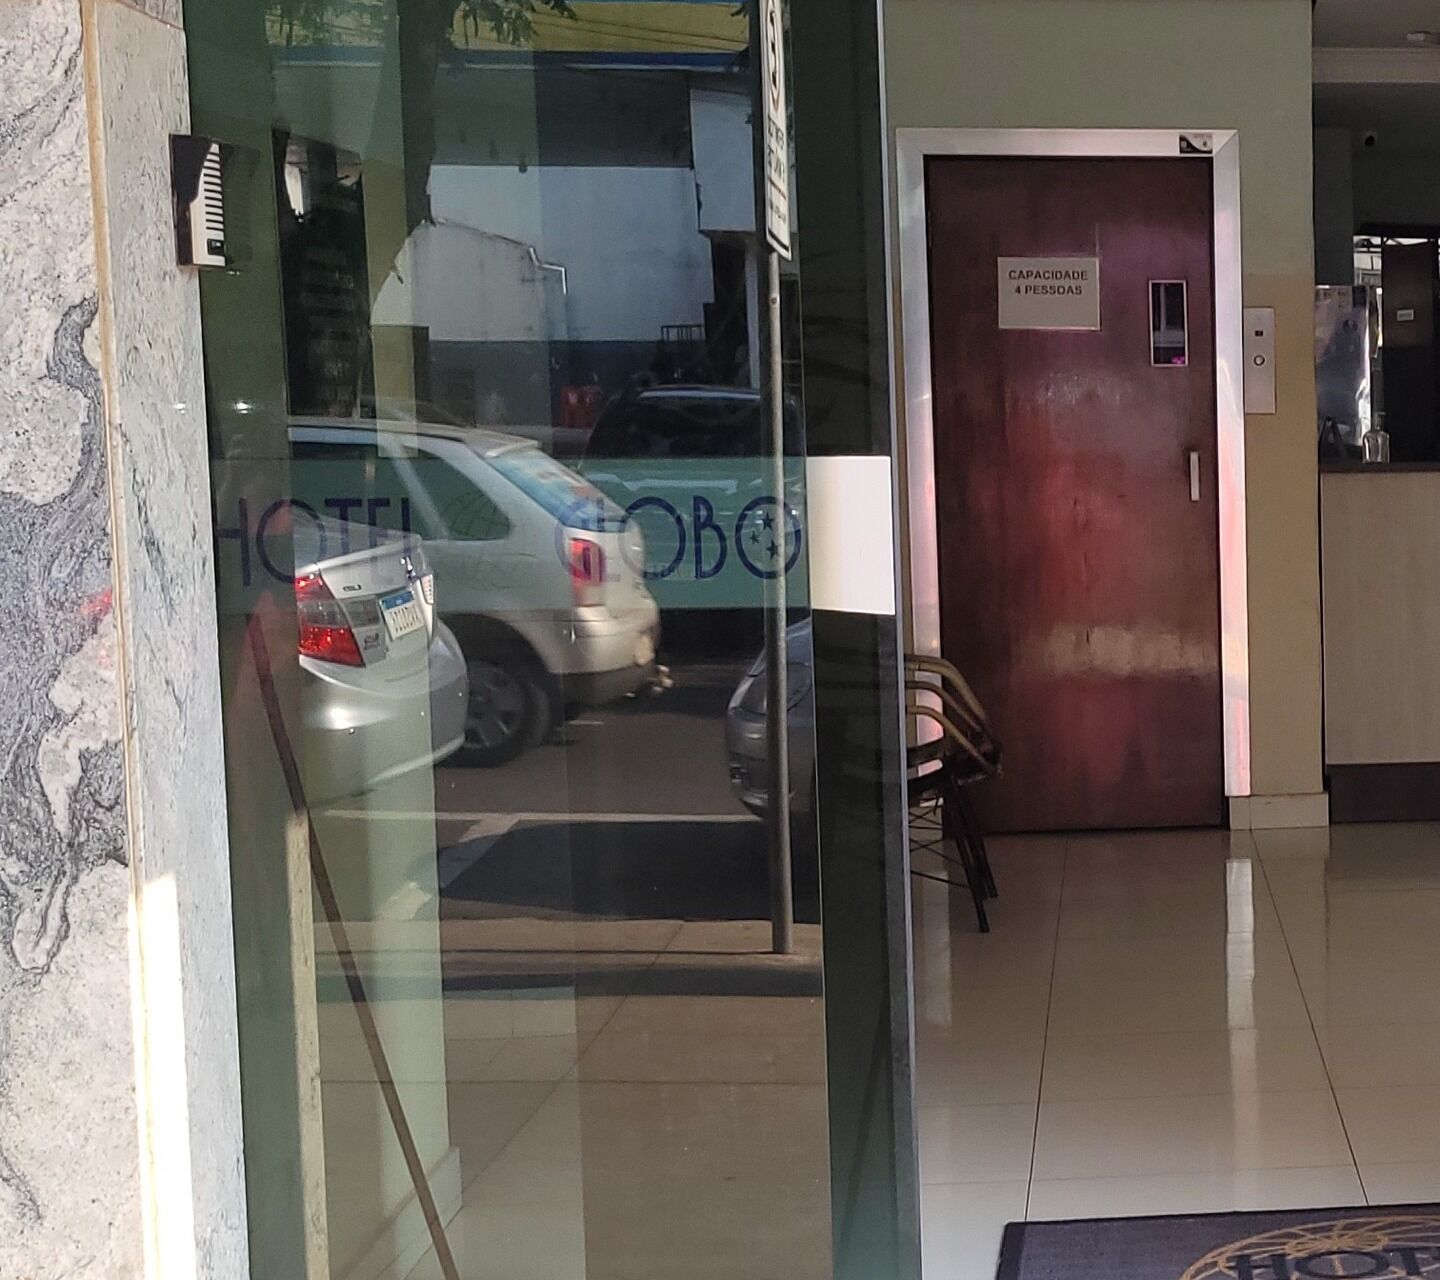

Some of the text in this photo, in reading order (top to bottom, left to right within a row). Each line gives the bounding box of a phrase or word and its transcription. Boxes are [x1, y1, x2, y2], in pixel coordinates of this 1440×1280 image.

[1008, 270, 1088, 281] CAPACIDADE
[1015, 285, 1082, 295] 4 PESSOAS
